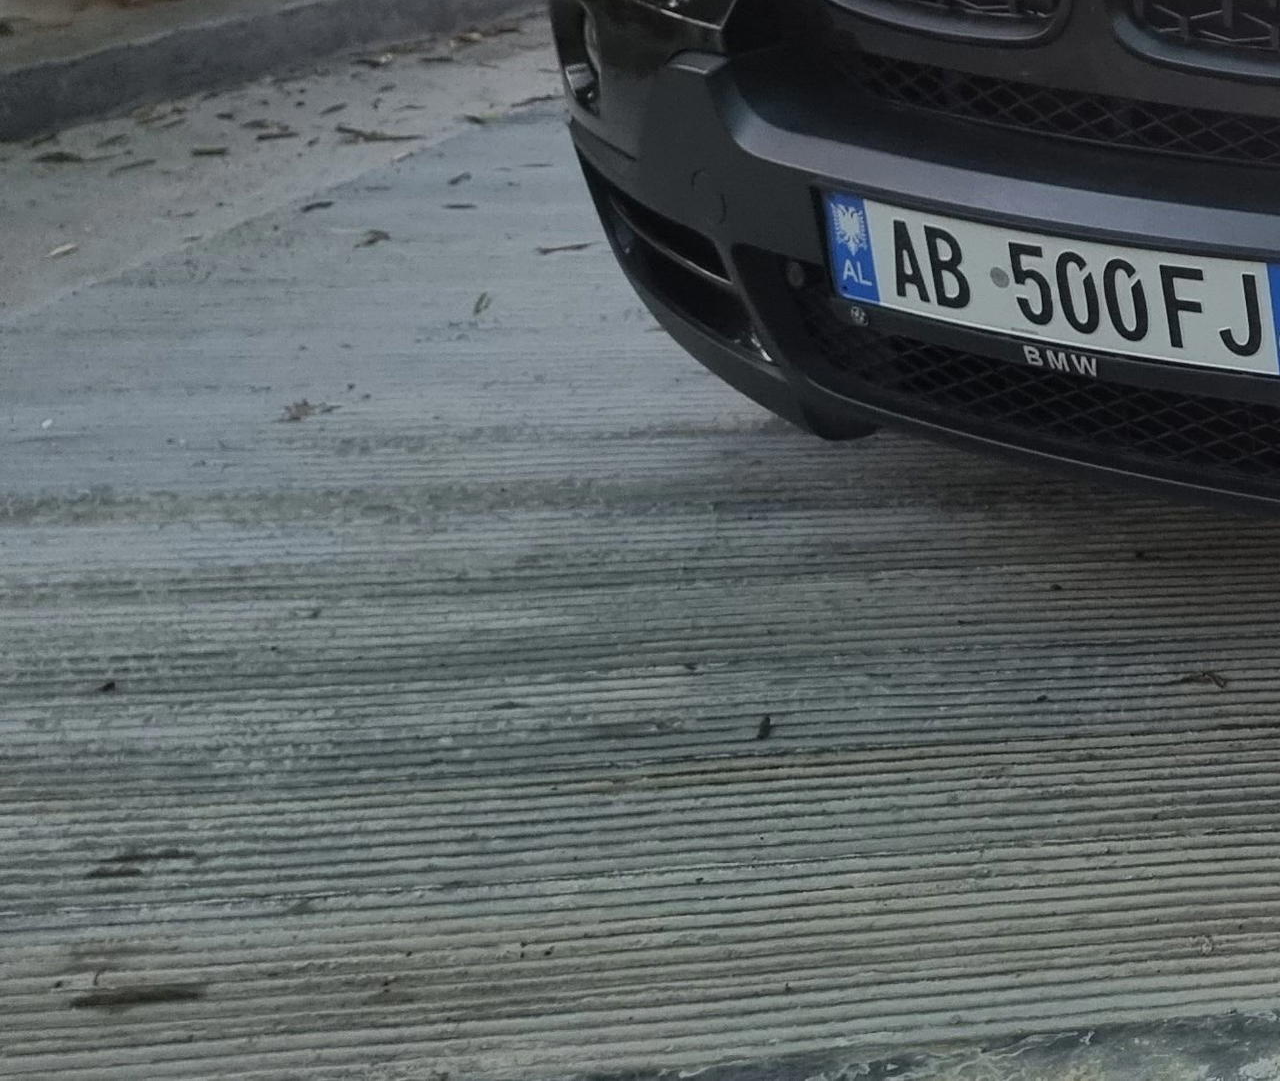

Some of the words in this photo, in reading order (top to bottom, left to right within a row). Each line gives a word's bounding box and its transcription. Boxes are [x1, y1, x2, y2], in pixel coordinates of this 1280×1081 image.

[842, 259, 873, 286] AL
[893, 219, 971, 309] AB
[1022, 345, 1097, 377] BMW
